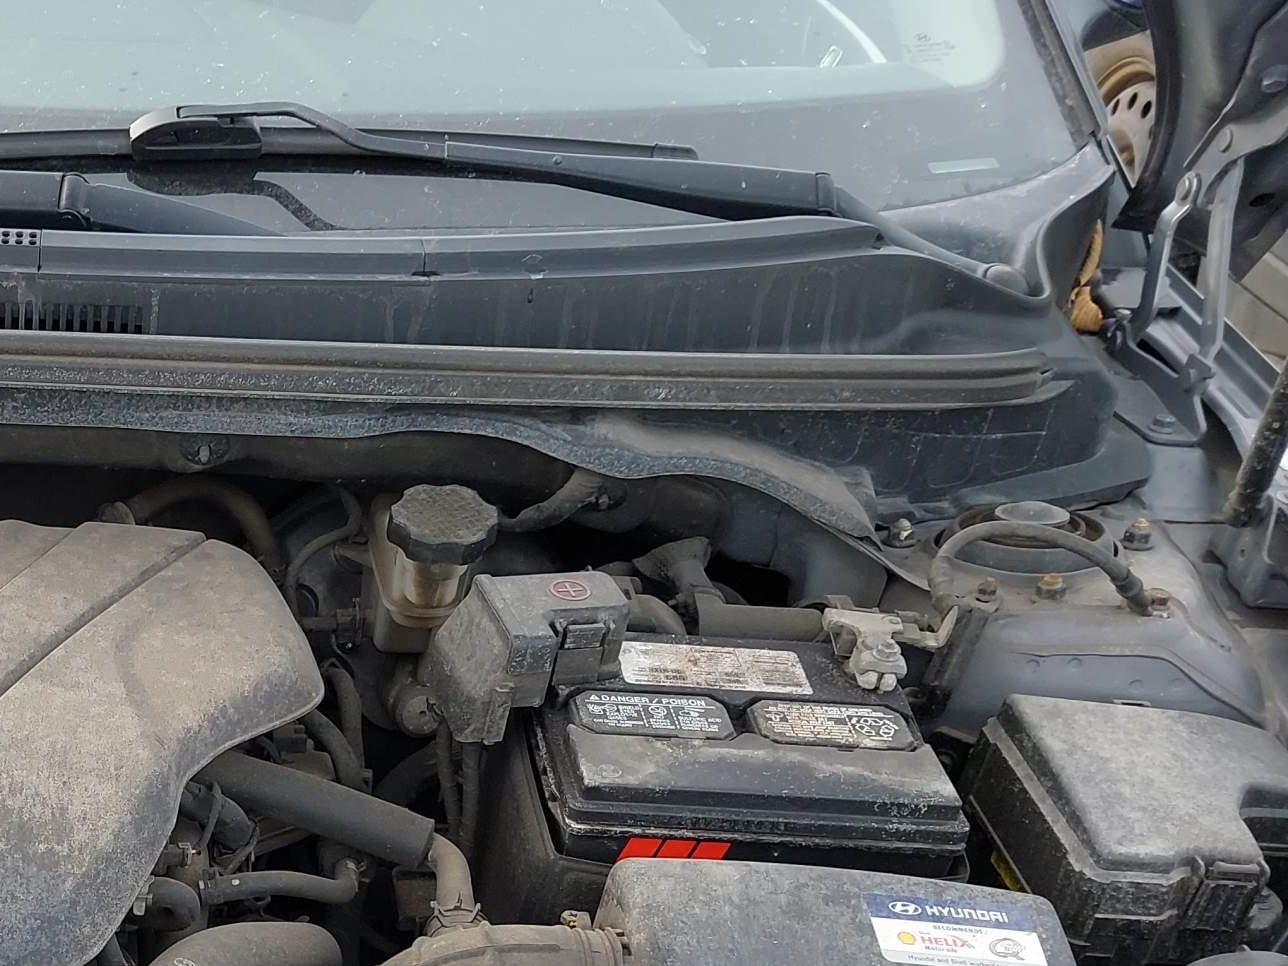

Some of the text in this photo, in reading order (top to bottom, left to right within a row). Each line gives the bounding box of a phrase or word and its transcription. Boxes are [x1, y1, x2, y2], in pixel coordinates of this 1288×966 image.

[601, 694, 650, 704] DANGER
[662, 698, 706, 706] POISON
[925, 905, 1009, 923] HYUNDAI
